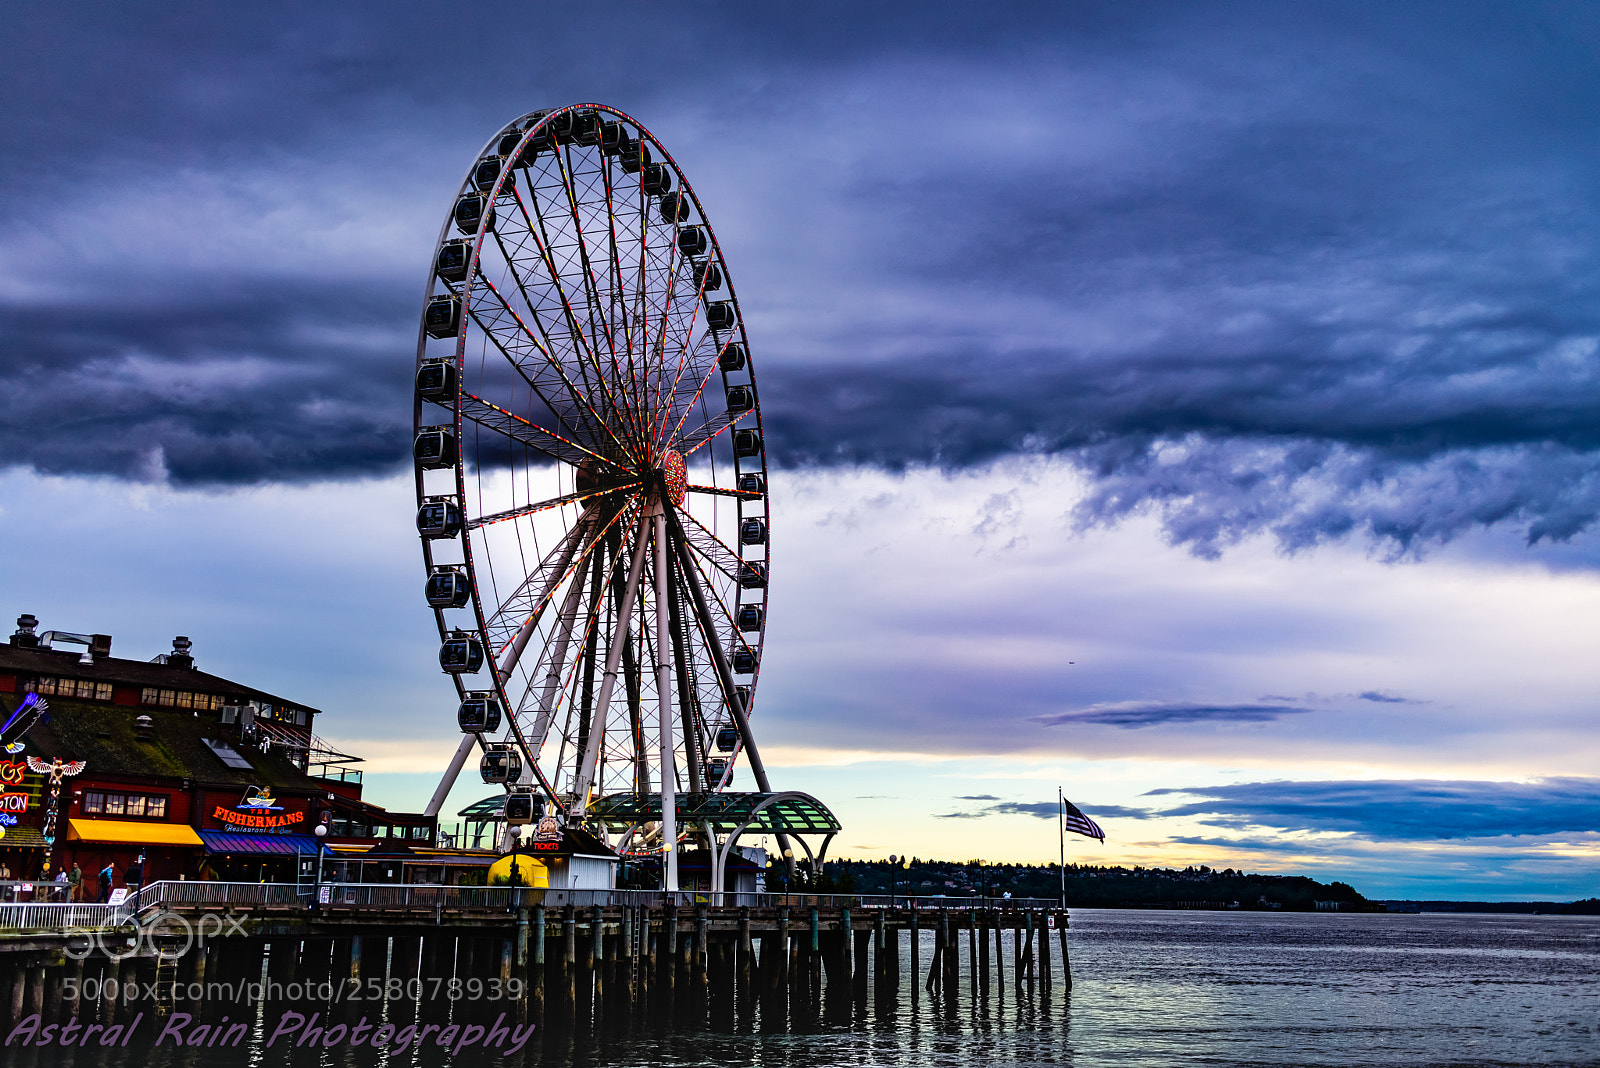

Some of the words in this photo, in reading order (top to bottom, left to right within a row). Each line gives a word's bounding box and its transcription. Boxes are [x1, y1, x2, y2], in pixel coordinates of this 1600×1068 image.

[0, 763, 26, 783] GS
[212, 805, 304, 827] FISHERMANS
[533, 842, 559, 851] TICKETS
